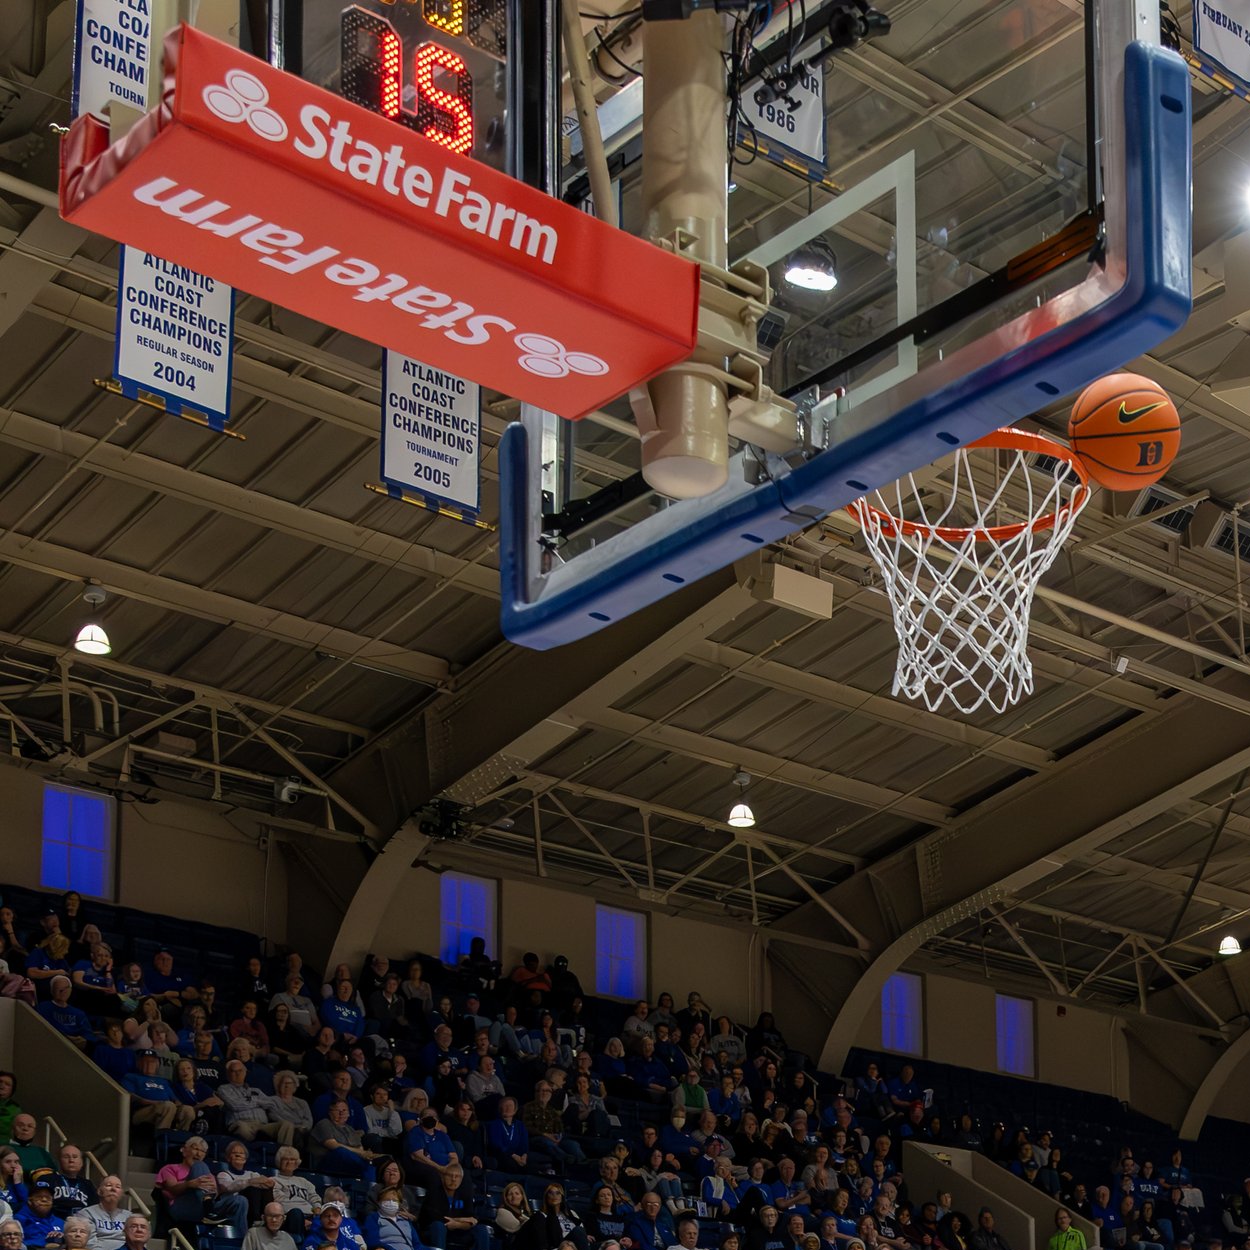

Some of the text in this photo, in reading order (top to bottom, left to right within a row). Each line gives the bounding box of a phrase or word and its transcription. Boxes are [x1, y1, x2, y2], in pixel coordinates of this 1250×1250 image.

[382, 33, 473, 154] 15
[758, 104, 795, 133] 1986
[143, 252, 214, 293] ATLANTIC
[155, 276, 204, 308] COAST
[126, 286, 227, 339] CONFERENCE
[130, 308, 222, 357] CHAMPIONS
[136, 335, 214, 373] REGULAR SEASON
[153, 361, 196, 391] 2004
[402, 360, 465, 395] ATLANTIC
[412, 382, 455, 410] COAST
[389, 392, 477, 437] CONFERENCE
[393, 413, 473, 454] CHAMPIONS
[406, 441, 459, 467] TOURNAMENT
[413, 462, 450, 488] 2005
